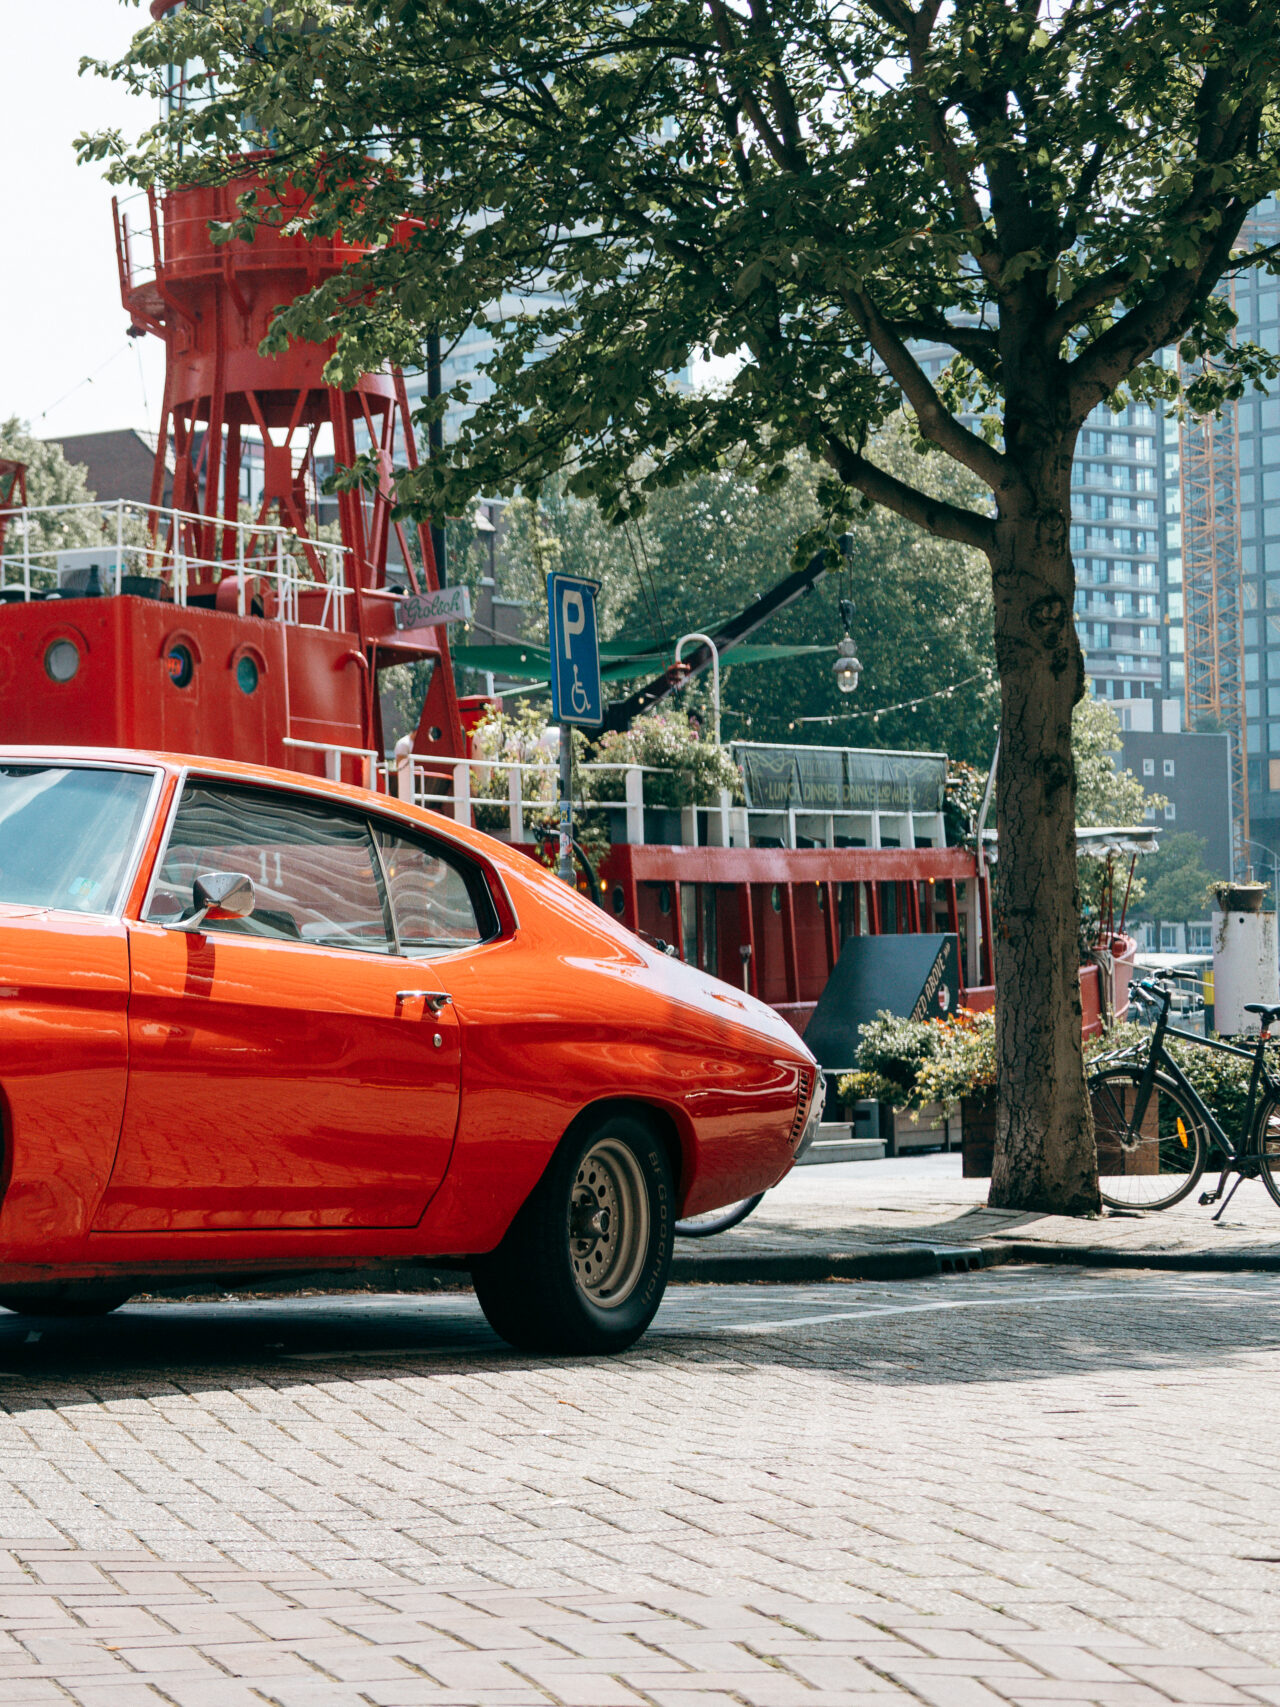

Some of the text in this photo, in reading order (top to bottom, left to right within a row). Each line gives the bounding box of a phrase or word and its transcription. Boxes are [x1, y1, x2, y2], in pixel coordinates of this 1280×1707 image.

[404, 591, 460, 627] Grolsch
[563, 589, 585, 660] P
[804, 783, 839, 803] DINNER
[843, 784, 876, 803] DRINKS
[925, 953, 946, 1002] ABOVE
